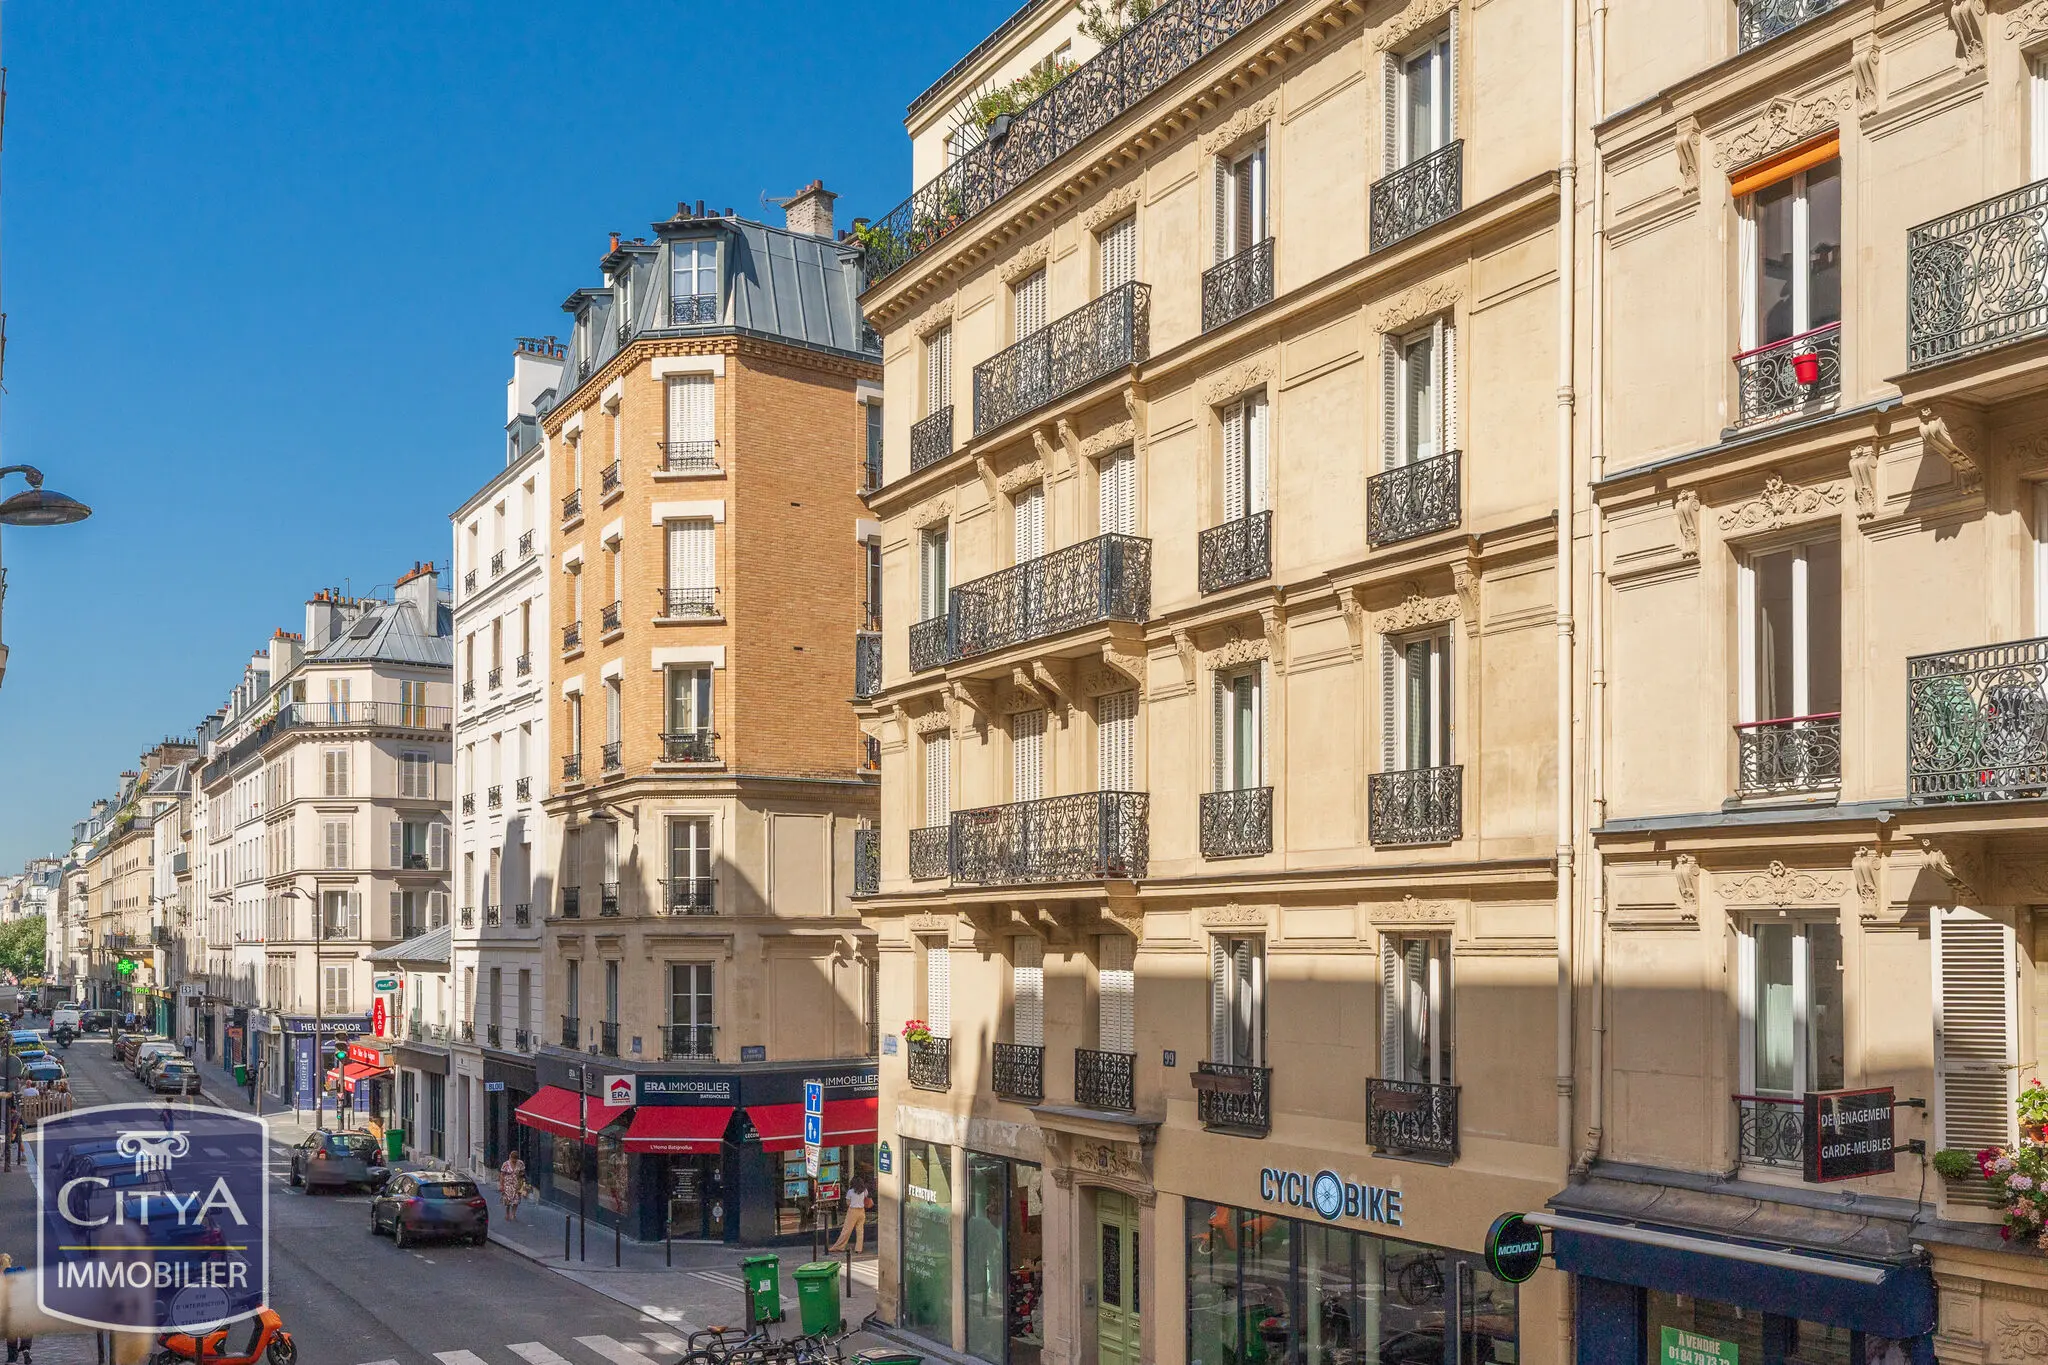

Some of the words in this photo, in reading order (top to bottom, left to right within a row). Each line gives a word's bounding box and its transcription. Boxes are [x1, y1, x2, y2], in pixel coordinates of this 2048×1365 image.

[301, 1023, 361, 1031] HEUIN-COLOR
[1165, 1052, 1174, 1065] 99
[644, 1082, 666, 1091] ERA
[668, 1082, 730, 1091] IMMOBILIER
[825, 1074, 879, 1086] IMMOBILIER
[1821, 1107, 1891, 1127] DEMENAGEMENT
[1821, 1137, 1892, 1159] GARDE-MEUBLES
[1498, 1242, 1539, 1256] MOOVOLT
[1686, 1335, 1720, 1355] VENDRE
[1669, 1346, 1678, 1359] 01
[1681, 1349, 1692, 1363] 84
